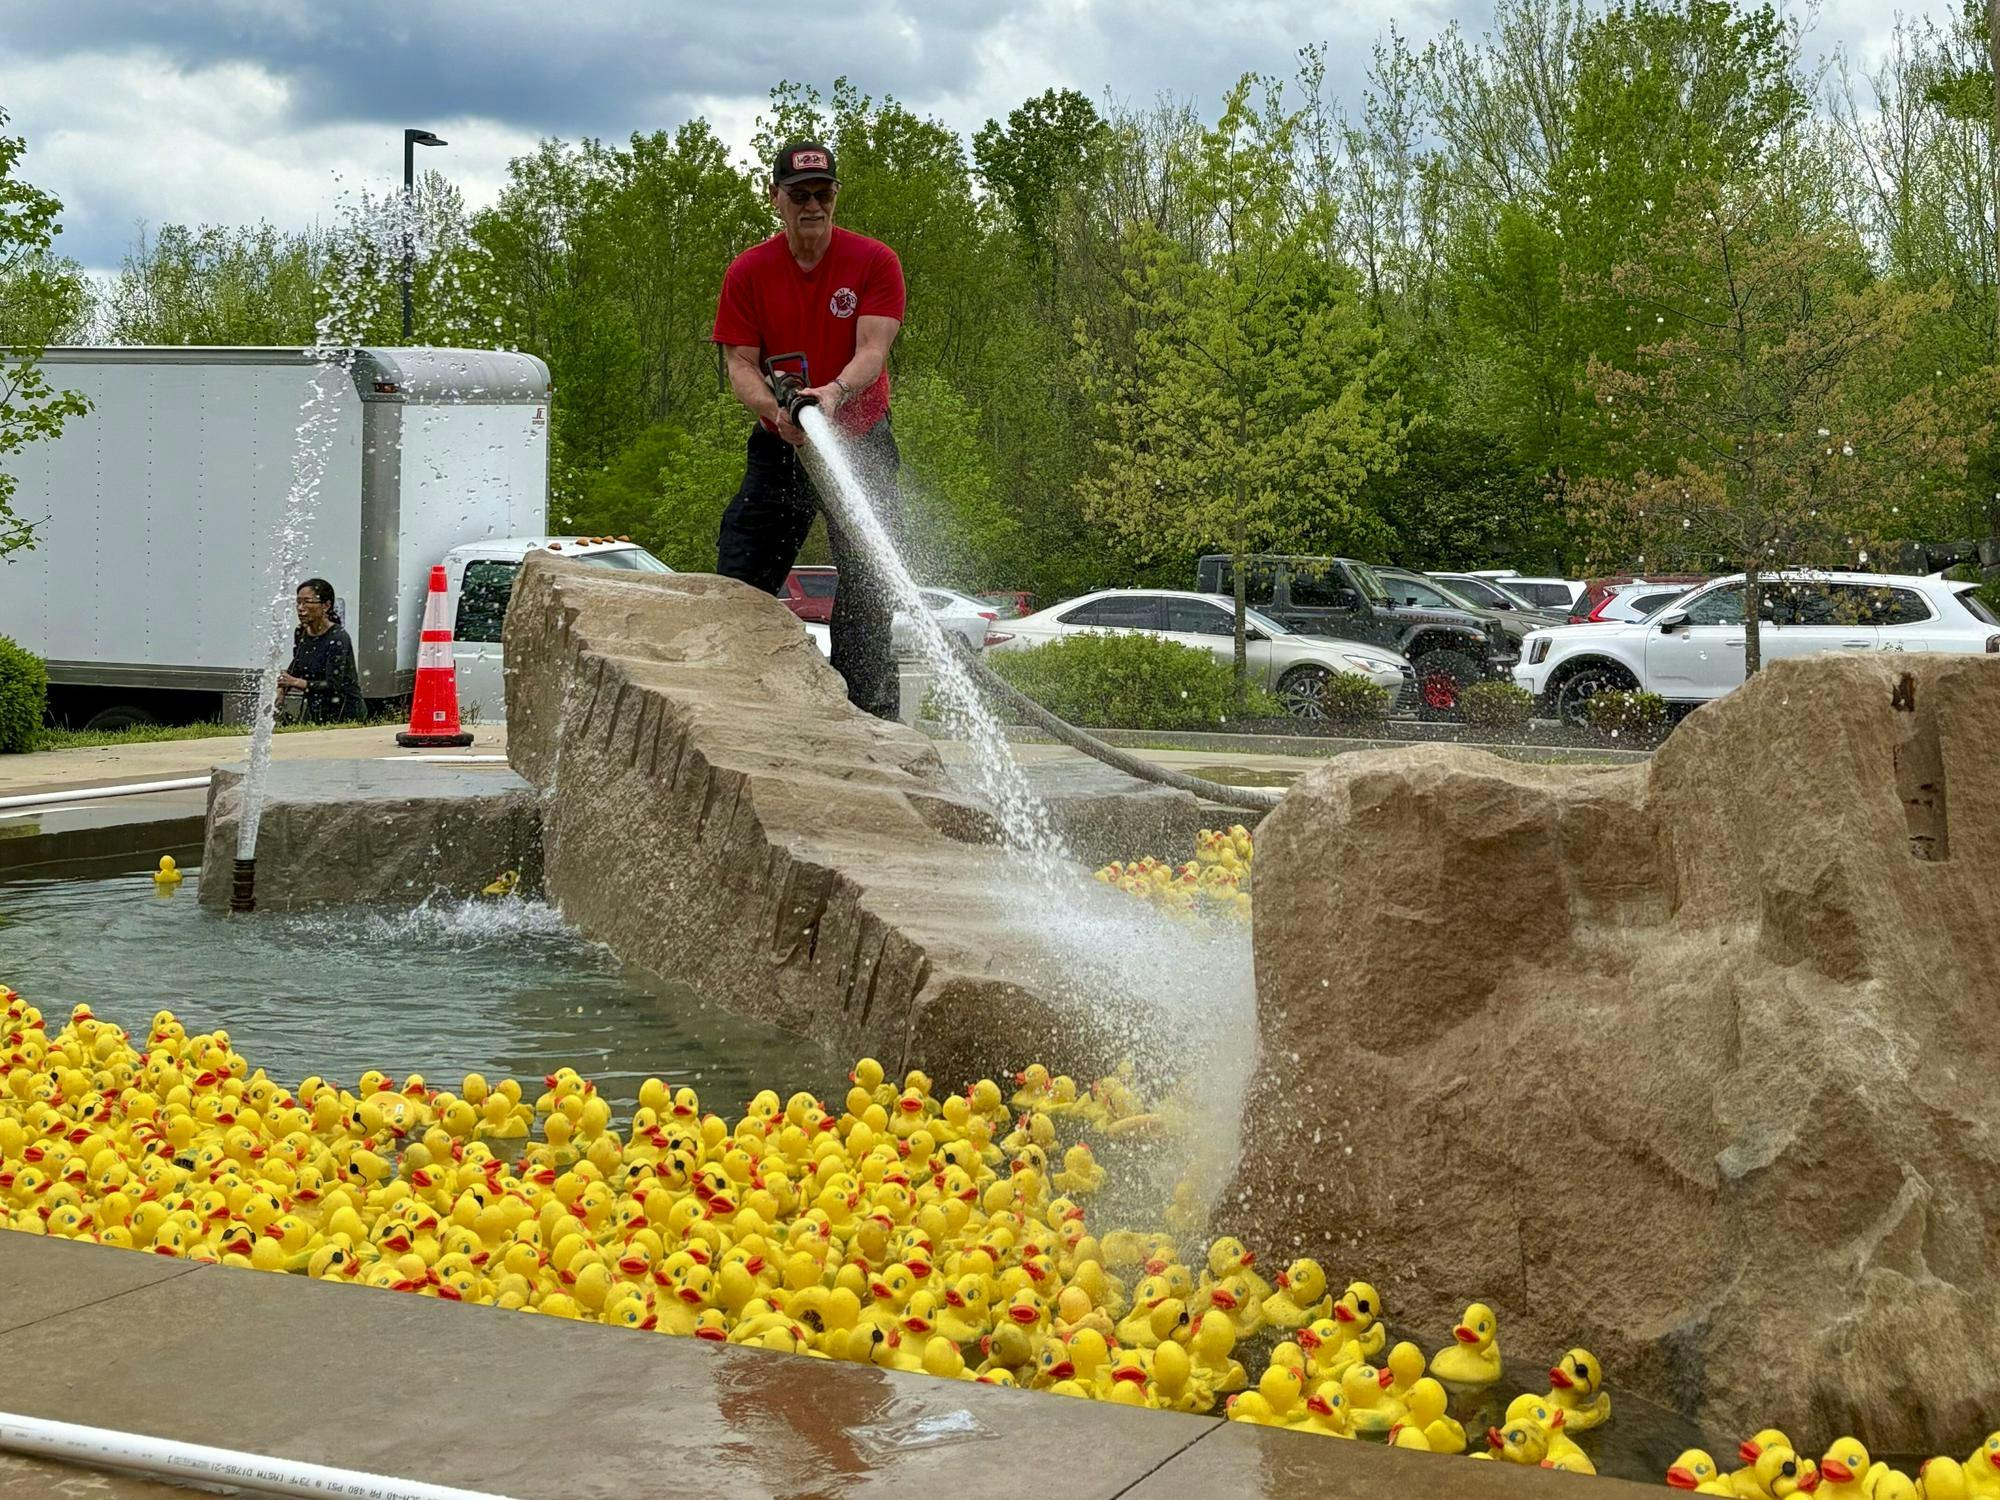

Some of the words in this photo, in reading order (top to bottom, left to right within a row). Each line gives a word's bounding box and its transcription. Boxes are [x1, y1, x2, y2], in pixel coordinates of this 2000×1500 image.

[327, 1482, 344, 1493] PSI
[348, 1485, 365, 1496] 480
[369, 1489, 382, 1500] PR
